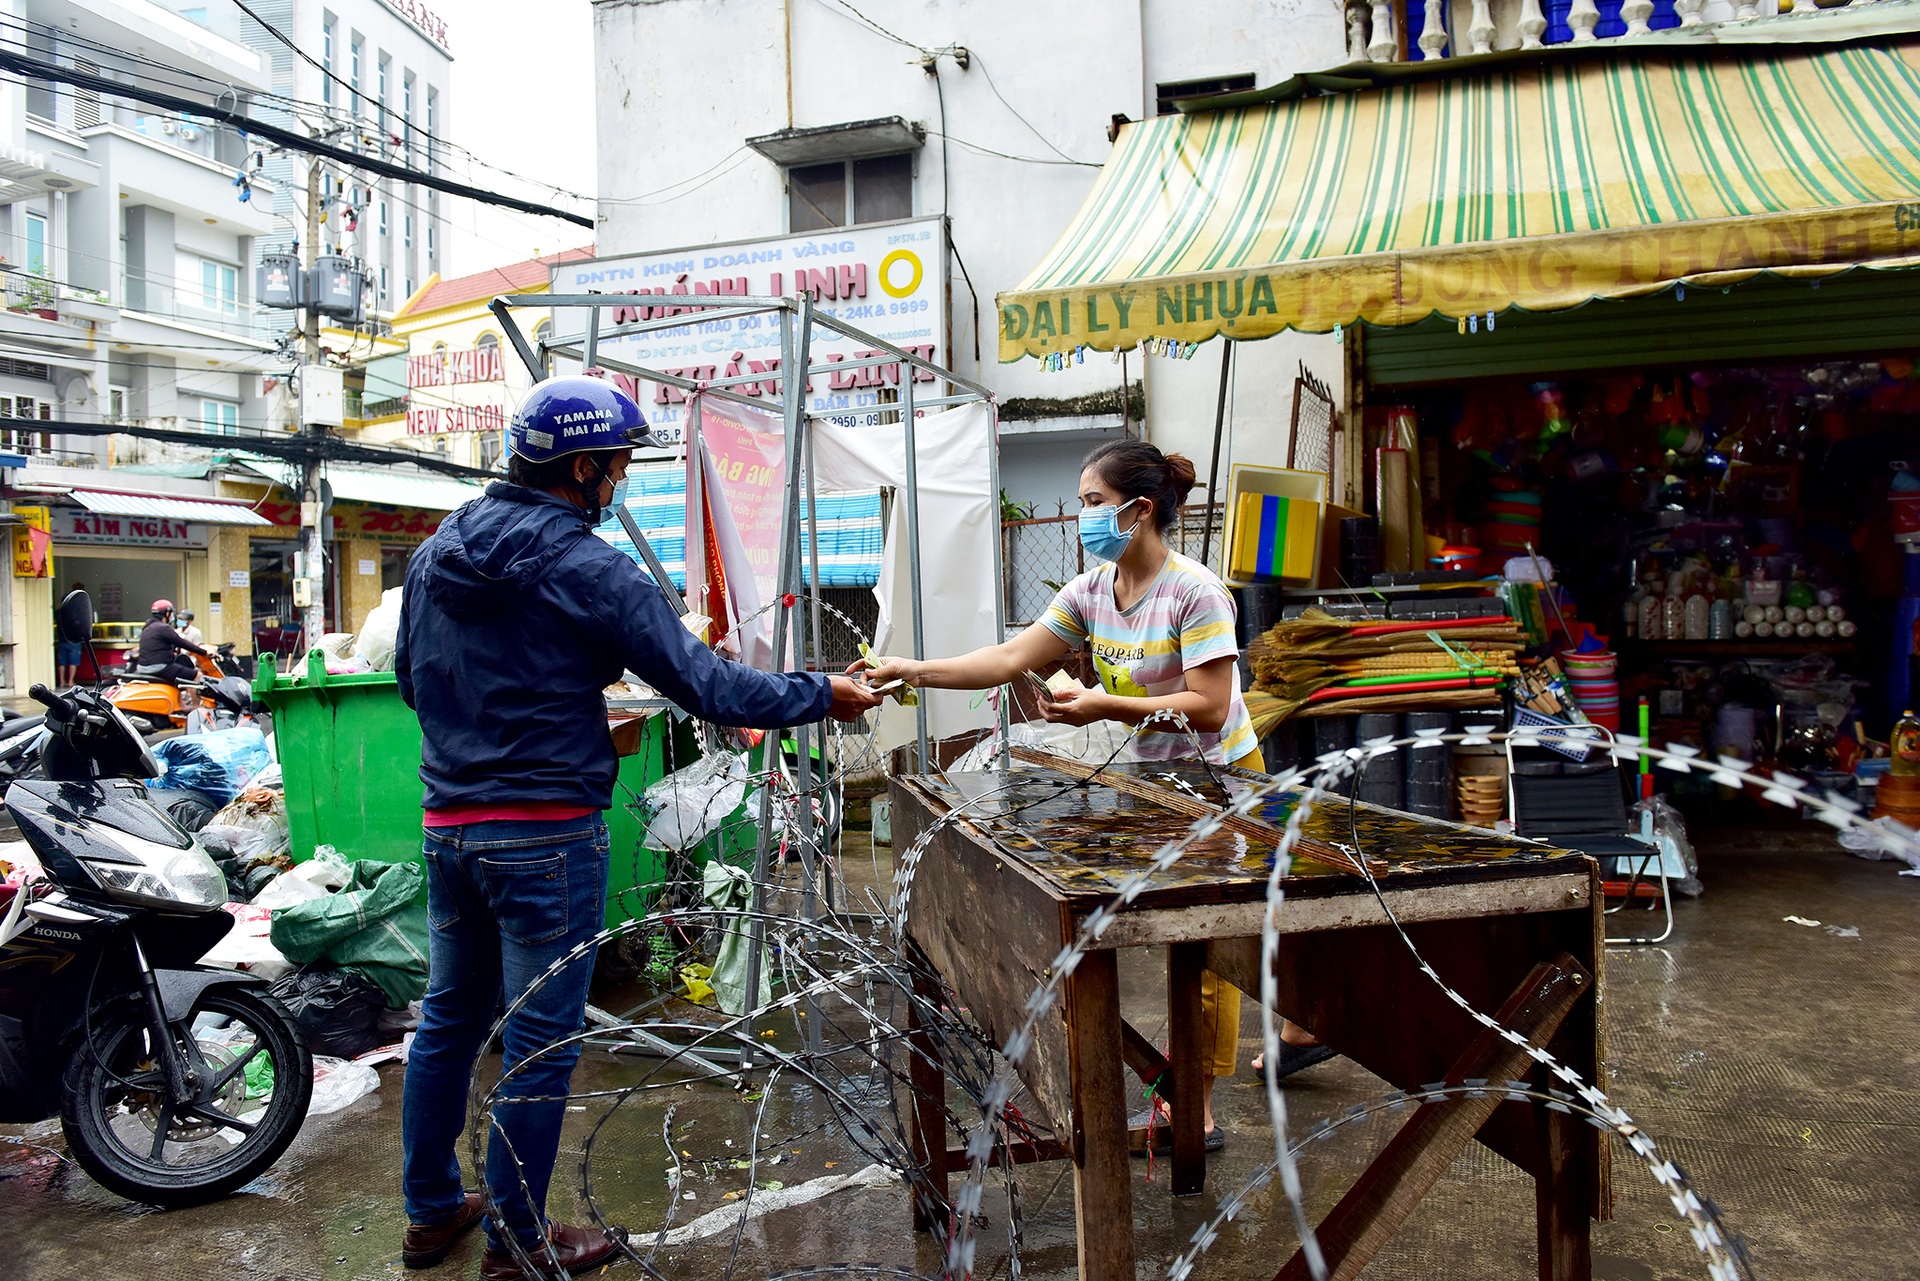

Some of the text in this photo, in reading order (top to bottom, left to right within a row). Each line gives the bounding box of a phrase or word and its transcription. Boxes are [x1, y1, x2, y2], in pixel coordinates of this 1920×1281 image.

[576, 240, 855, 285] DNTN KINH DOANH VÀNG
[890, 299, 929, 315] 9999
[1004, 270, 1278, 346] ĐẠI LÝ NHỰA
[637, 344, 697, 360] DNTN
[450, 347, 505, 384] KHOA
[406, 409, 439, 435] NEW
[553, 409, 614, 425] YAMAHA
[563, 422, 611, 437] MAI AN
[129, 518, 188, 539] NGÂN
[34, 927, 82, 940] HONDA
